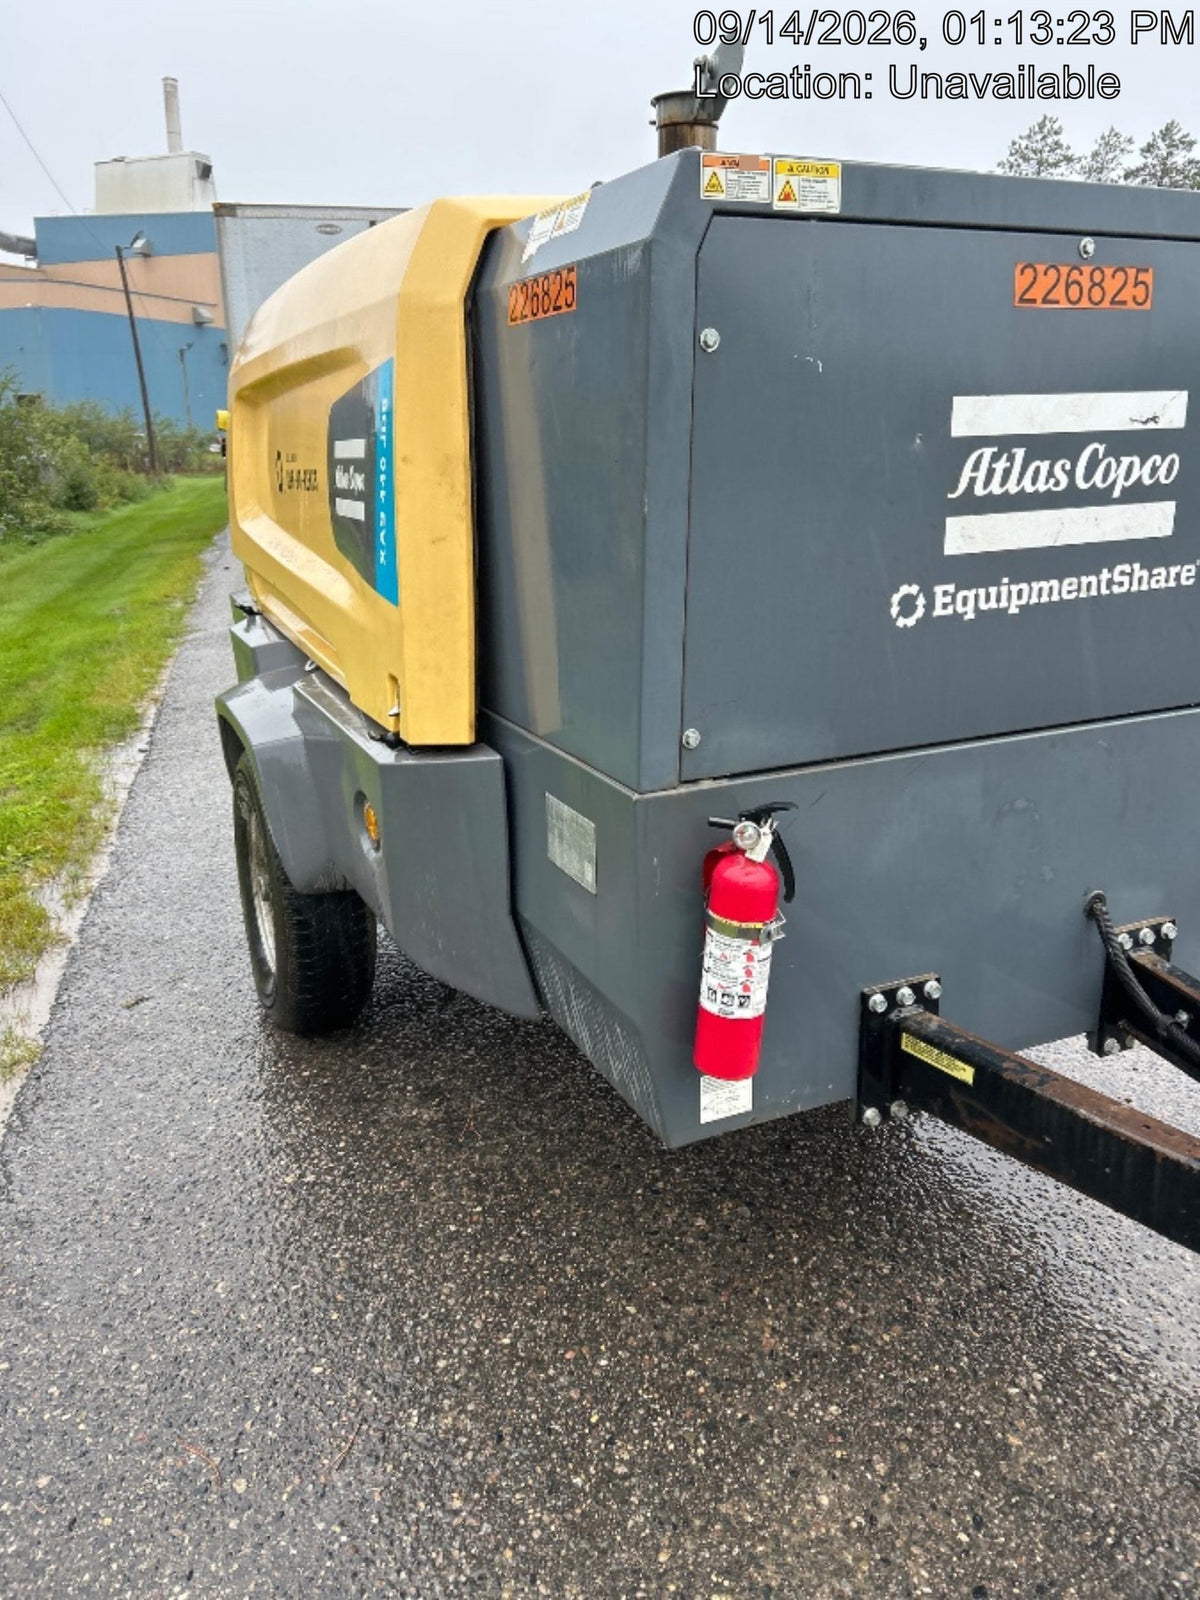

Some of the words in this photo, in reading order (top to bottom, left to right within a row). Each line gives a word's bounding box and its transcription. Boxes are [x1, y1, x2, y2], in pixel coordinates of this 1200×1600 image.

[508, 266, 576, 323] 226825
[1017, 263, 1151, 306] 226825
[947, 446, 1071, 499] Atlas
[1074, 442, 1180, 499] Copco
[932, 562, 1196, 621] EquipmentShare
